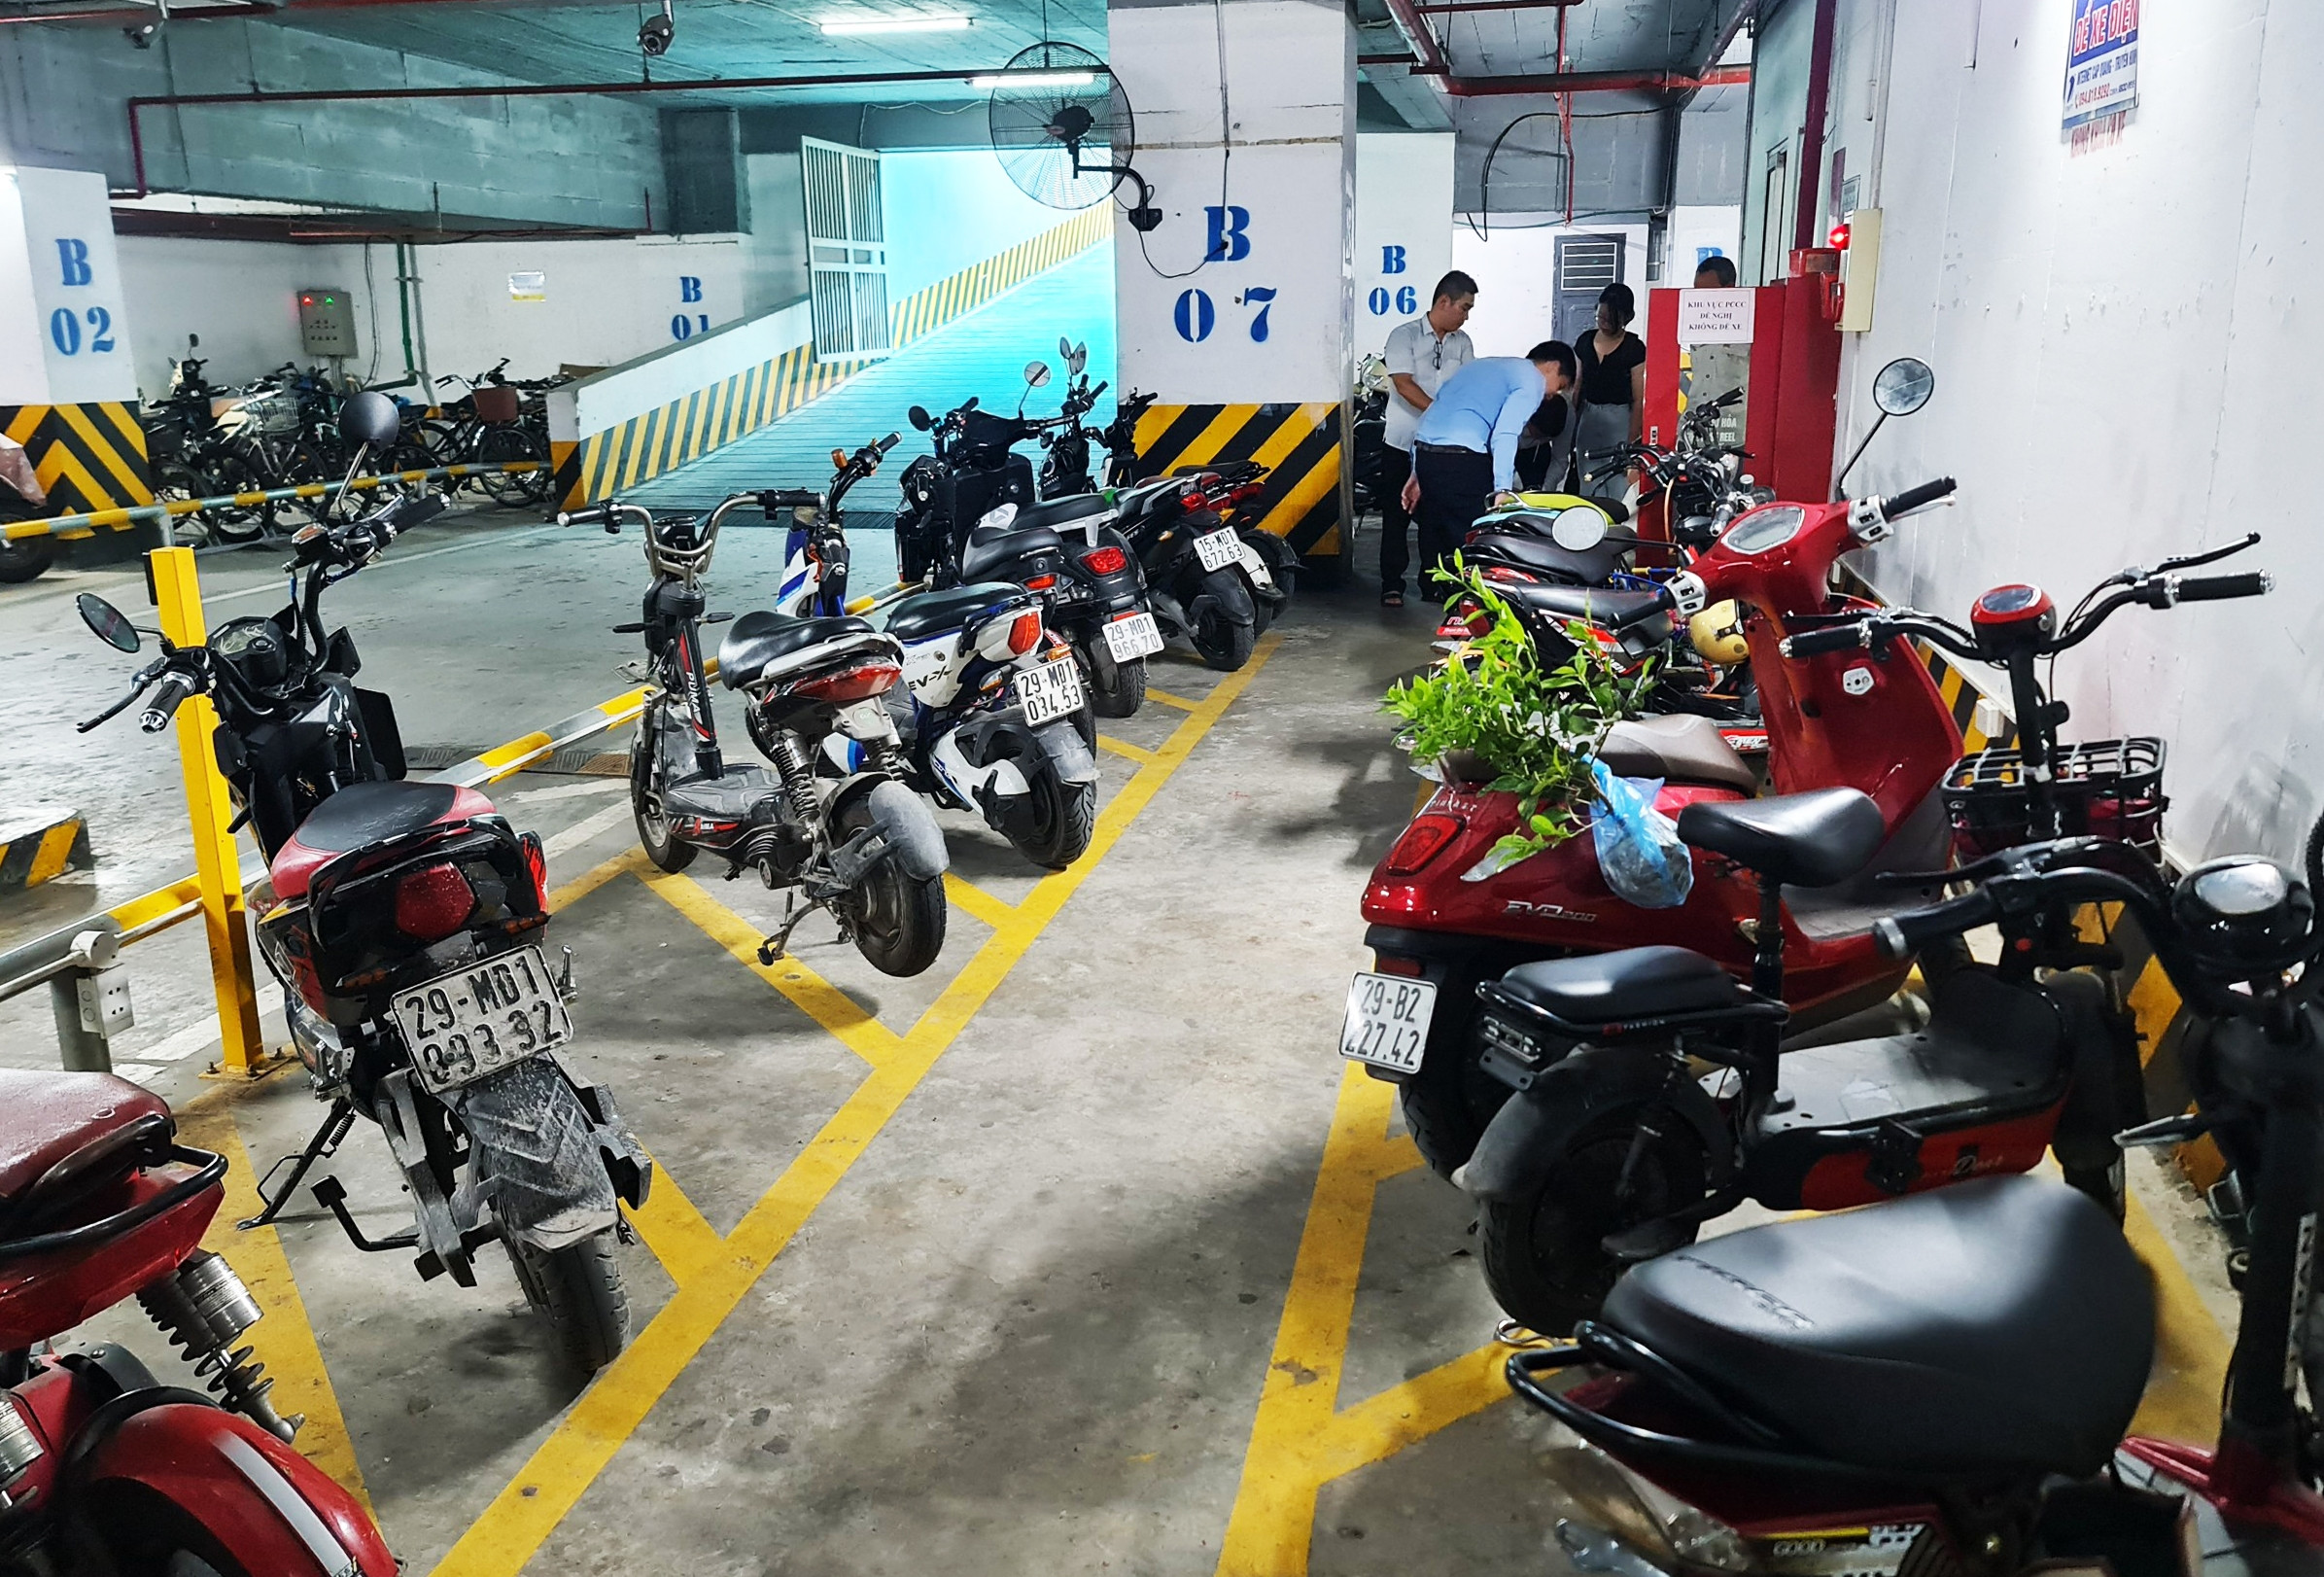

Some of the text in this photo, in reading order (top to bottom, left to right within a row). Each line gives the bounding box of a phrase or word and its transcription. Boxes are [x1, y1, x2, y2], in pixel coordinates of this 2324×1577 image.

[2090, 4, 2109, 49] XE
[1203, 206, 1251, 262] B
[54, 238, 92, 286] B
[1381, 245, 1406, 274] B
[679, 276, 703, 302] B
[1369, 286, 1417, 316] 06
[51, 306, 115, 356] 02
[672, 314, 710, 341] 01
[1719, 432, 1736, 442] REEL
[686, 672, 701, 713] PUMA
[1361, 979, 1421, 1023] 29-B2
